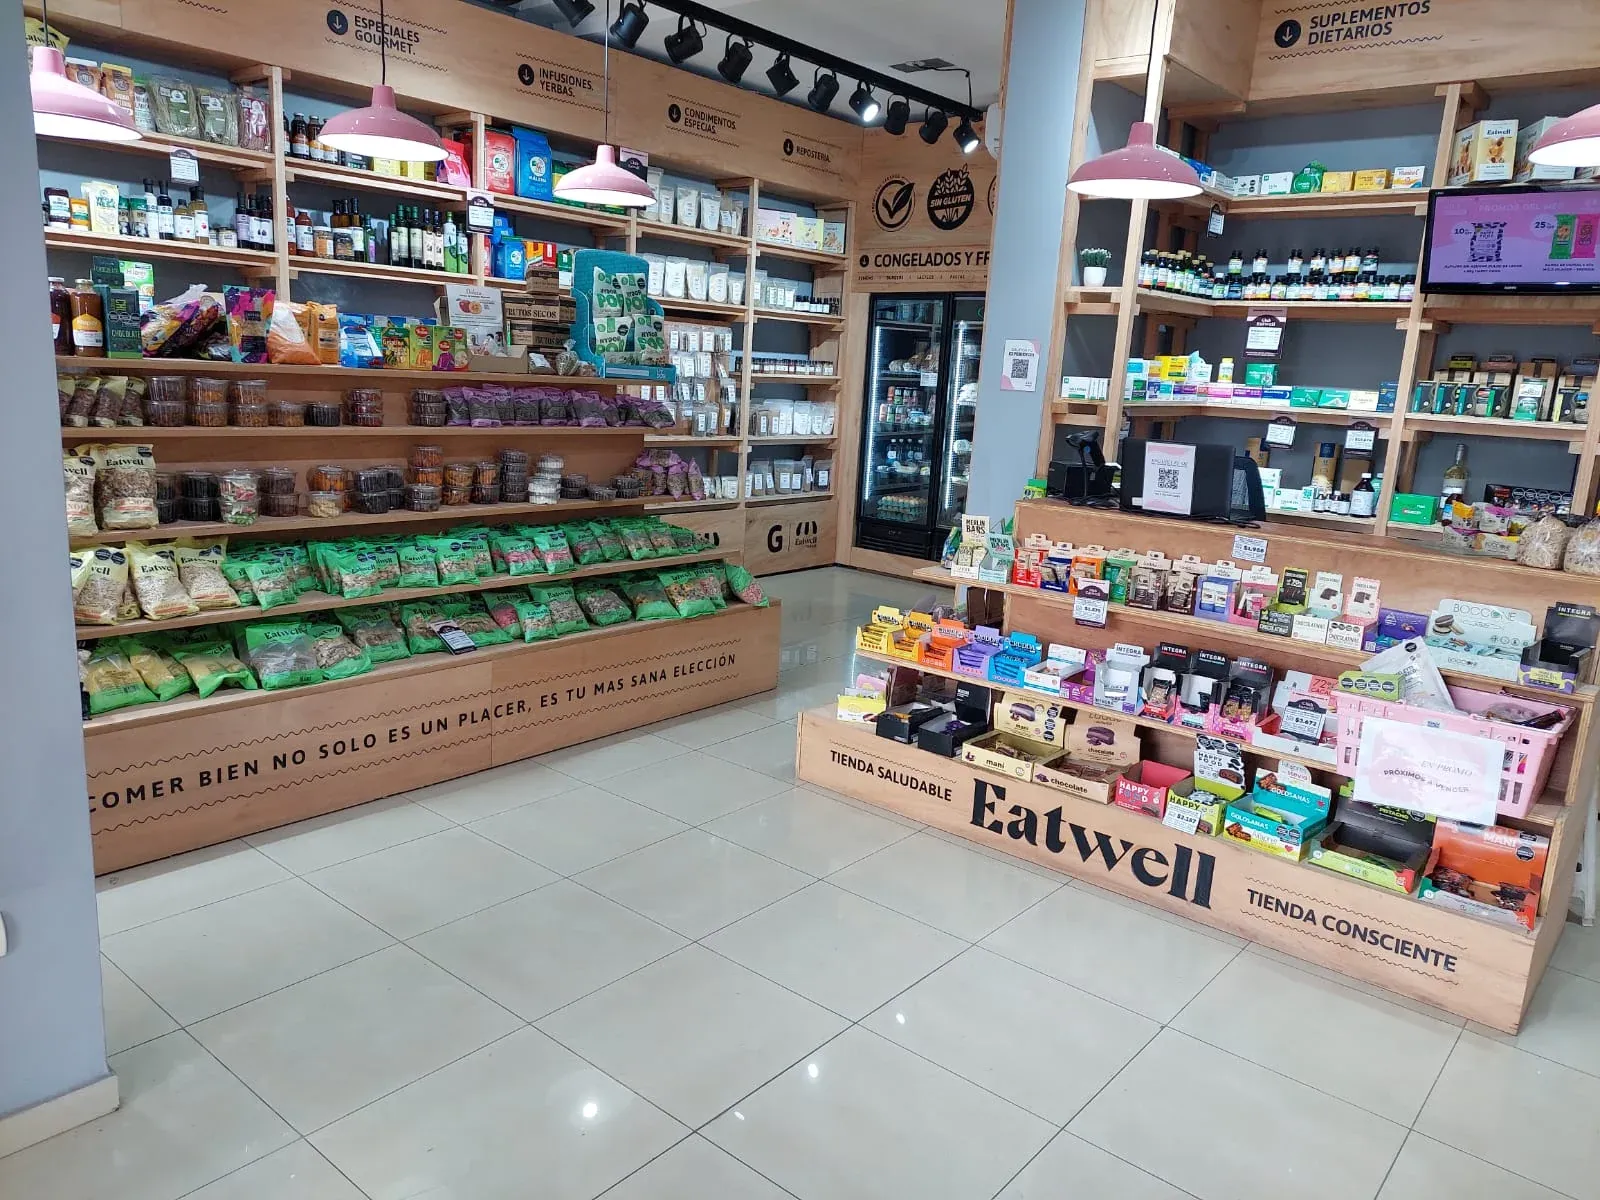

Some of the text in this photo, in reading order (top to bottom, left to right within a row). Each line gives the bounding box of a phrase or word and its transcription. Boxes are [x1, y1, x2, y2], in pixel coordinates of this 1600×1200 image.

[1310, 0, 1431, 29] SUPLEMENTOS
[354, 15, 420, 43] ESPECIALES
[1308, 22, 1392, 45] DIETARIOS
[355, 30, 416, 55] GOURMET.
[540, 80, 575, 98] YERBAS.
[930, 194, 971, 208] SIN GLUTEN
[874, 252, 961, 267] CONGELADOS
[964, 251, 973, 266] Y
[533, 309, 557, 319] SECOS
[106, 457, 144, 467] Eatwell
[966, 519, 986, 527] MERLIN
[966, 525, 986, 535] BARS
[767, 525, 783, 553] G
[1453, 603, 1517, 622] BOCCONE
[199, 759, 259, 788] BIEN
[272, 749, 306, 770] NO
[319, 733, 377, 760] SOLO
[388, 726, 411, 744] ES
[420, 717, 449, 736] UN
[458, 699, 532, 728] PLACER,
[540, 693, 558, 709] ES
[566, 686, 586, 702] TU
[594, 678, 625, 697] MAS
[630, 668, 668, 688] SANA
[673, 651, 736, 678] ELECCIÓN
[830, 750, 952, 802] TIENDA SALUDABLE
[1050, 777, 1088, 794] chocolate
[1119, 780, 1149, 795] HAPPY
[1169, 794, 1201, 810] HAPPY
[1230, 811, 1270, 830] GOLOSANAS
[970, 777, 1217, 910] Eatwell
[1247, 888, 1458, 973] TIENDA CONSCIENTE
